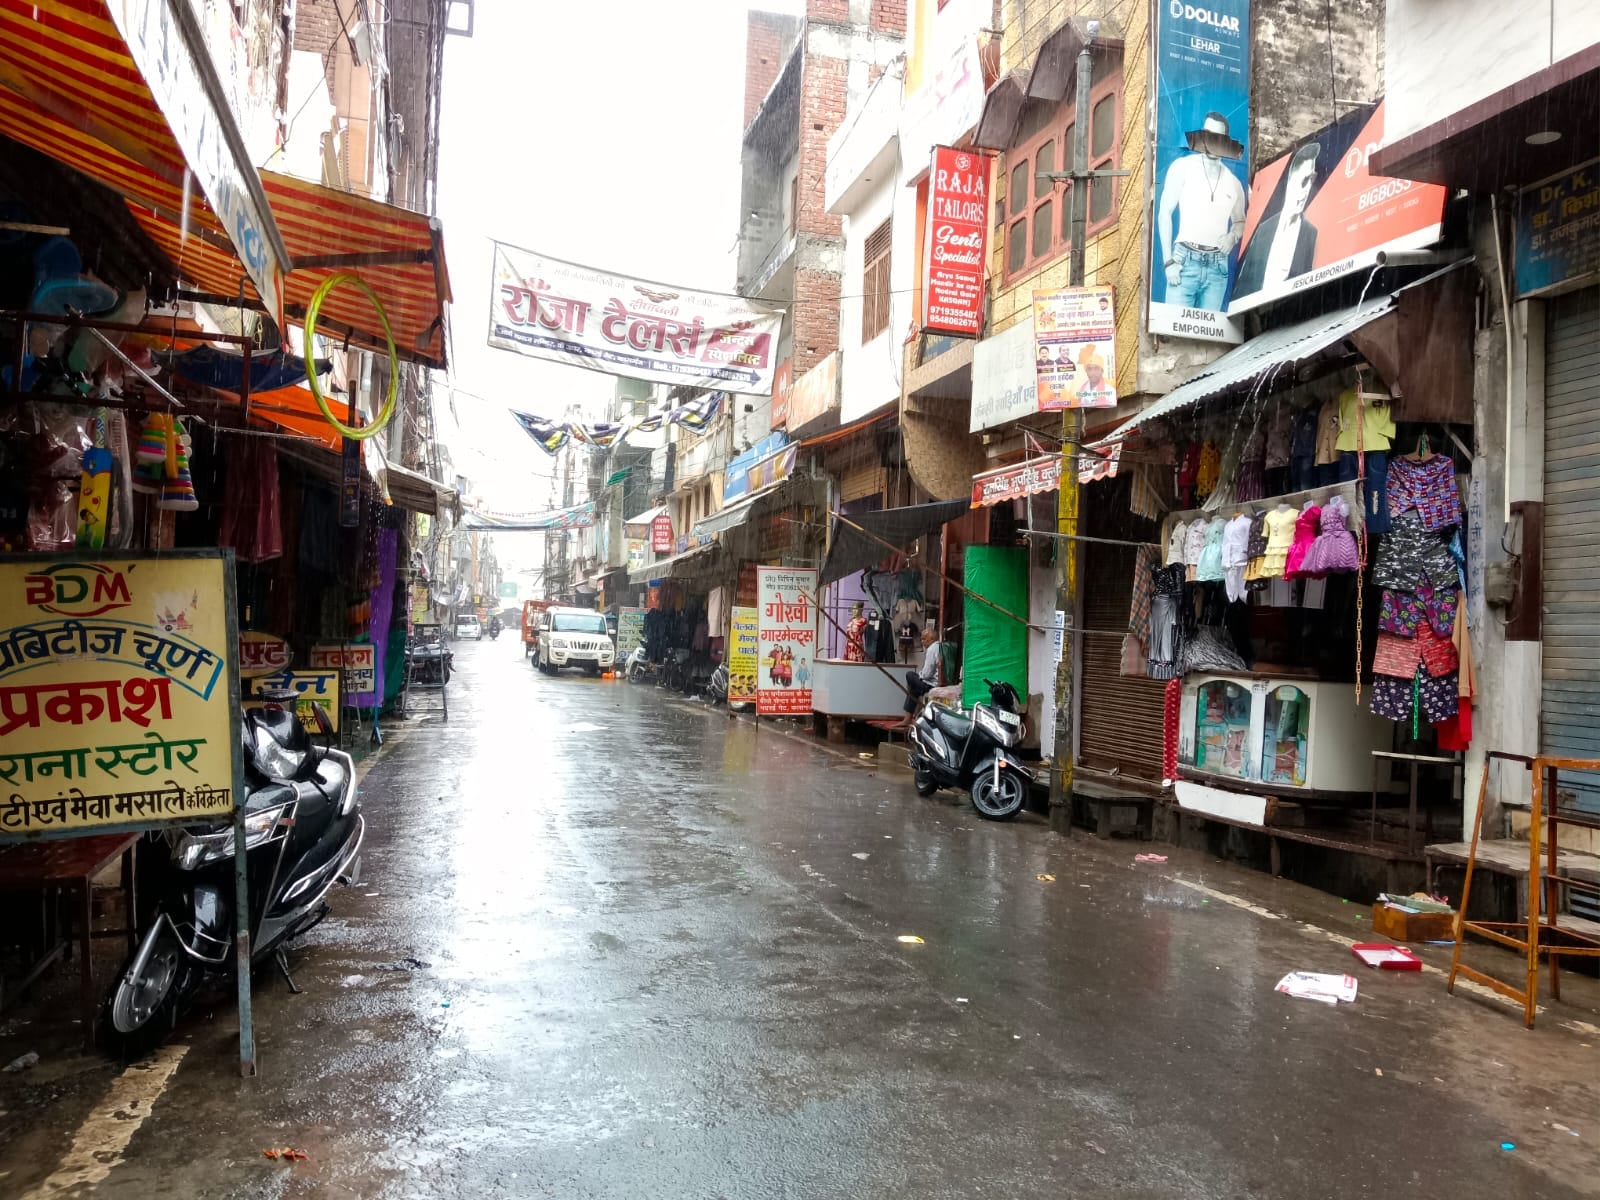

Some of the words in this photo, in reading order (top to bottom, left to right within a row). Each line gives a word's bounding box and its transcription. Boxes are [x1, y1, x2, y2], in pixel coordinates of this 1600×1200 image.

[1185, 5, 1240, 32] DOLLAR
[1190, 37, 1220, 53] LEHAR
[937, 169, 985, 196] RAJA
[1358, 179, 1412, 211] BIGBOSS
[936, 197, 984, 223] TAILORS
[1291, 274, 1314, 290] JESICA
[1314, 260, 1355, 283] EMPORIUM
[500, 284, 591, 336] राजा
[600, 297, 705, 359] टेलर्स
[1180, 308, 1216, 322] JAISIKA
[1172, 324, 1225, 338] EMPORIUM
[24, 571, 132, 605] BDM
[133, 630, 213, 680] चूर्ण
[0, 677, 173, 737] प्रकाश
[95, 732, 207, 779] स्टोर
[114, 780, 187, 817] मसाले
